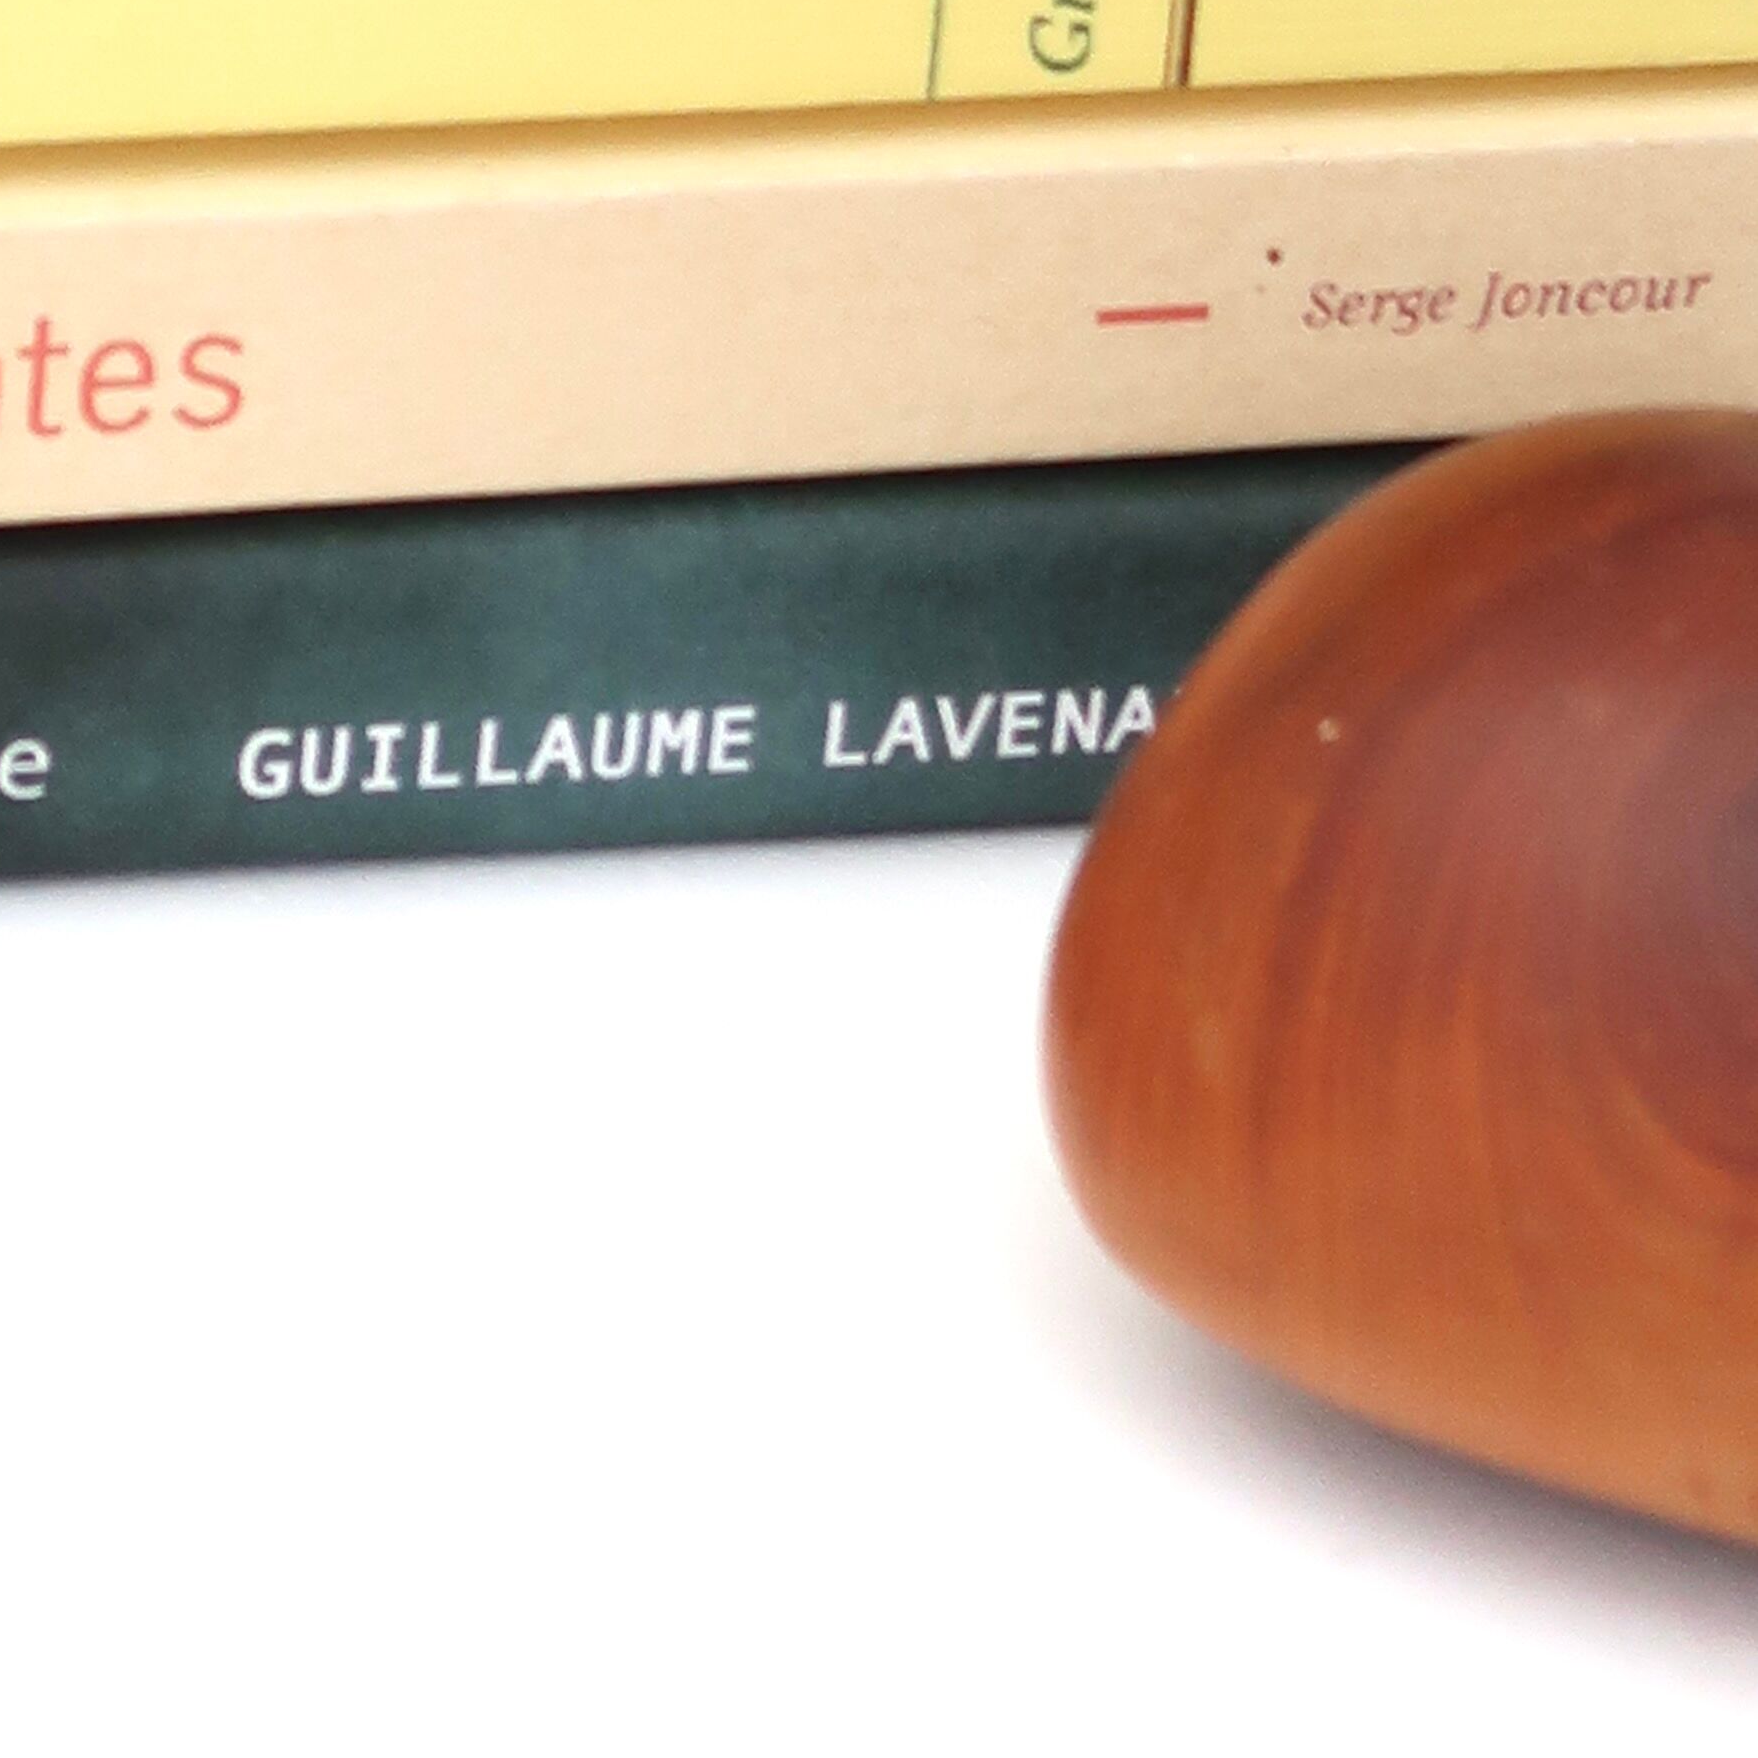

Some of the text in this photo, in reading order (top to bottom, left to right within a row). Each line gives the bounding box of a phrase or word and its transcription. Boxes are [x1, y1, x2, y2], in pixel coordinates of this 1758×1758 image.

[1300, 271, 1713, 334] Serge Joncour
[237, 685, 1180, 800] GUILLAUME LAVENA
